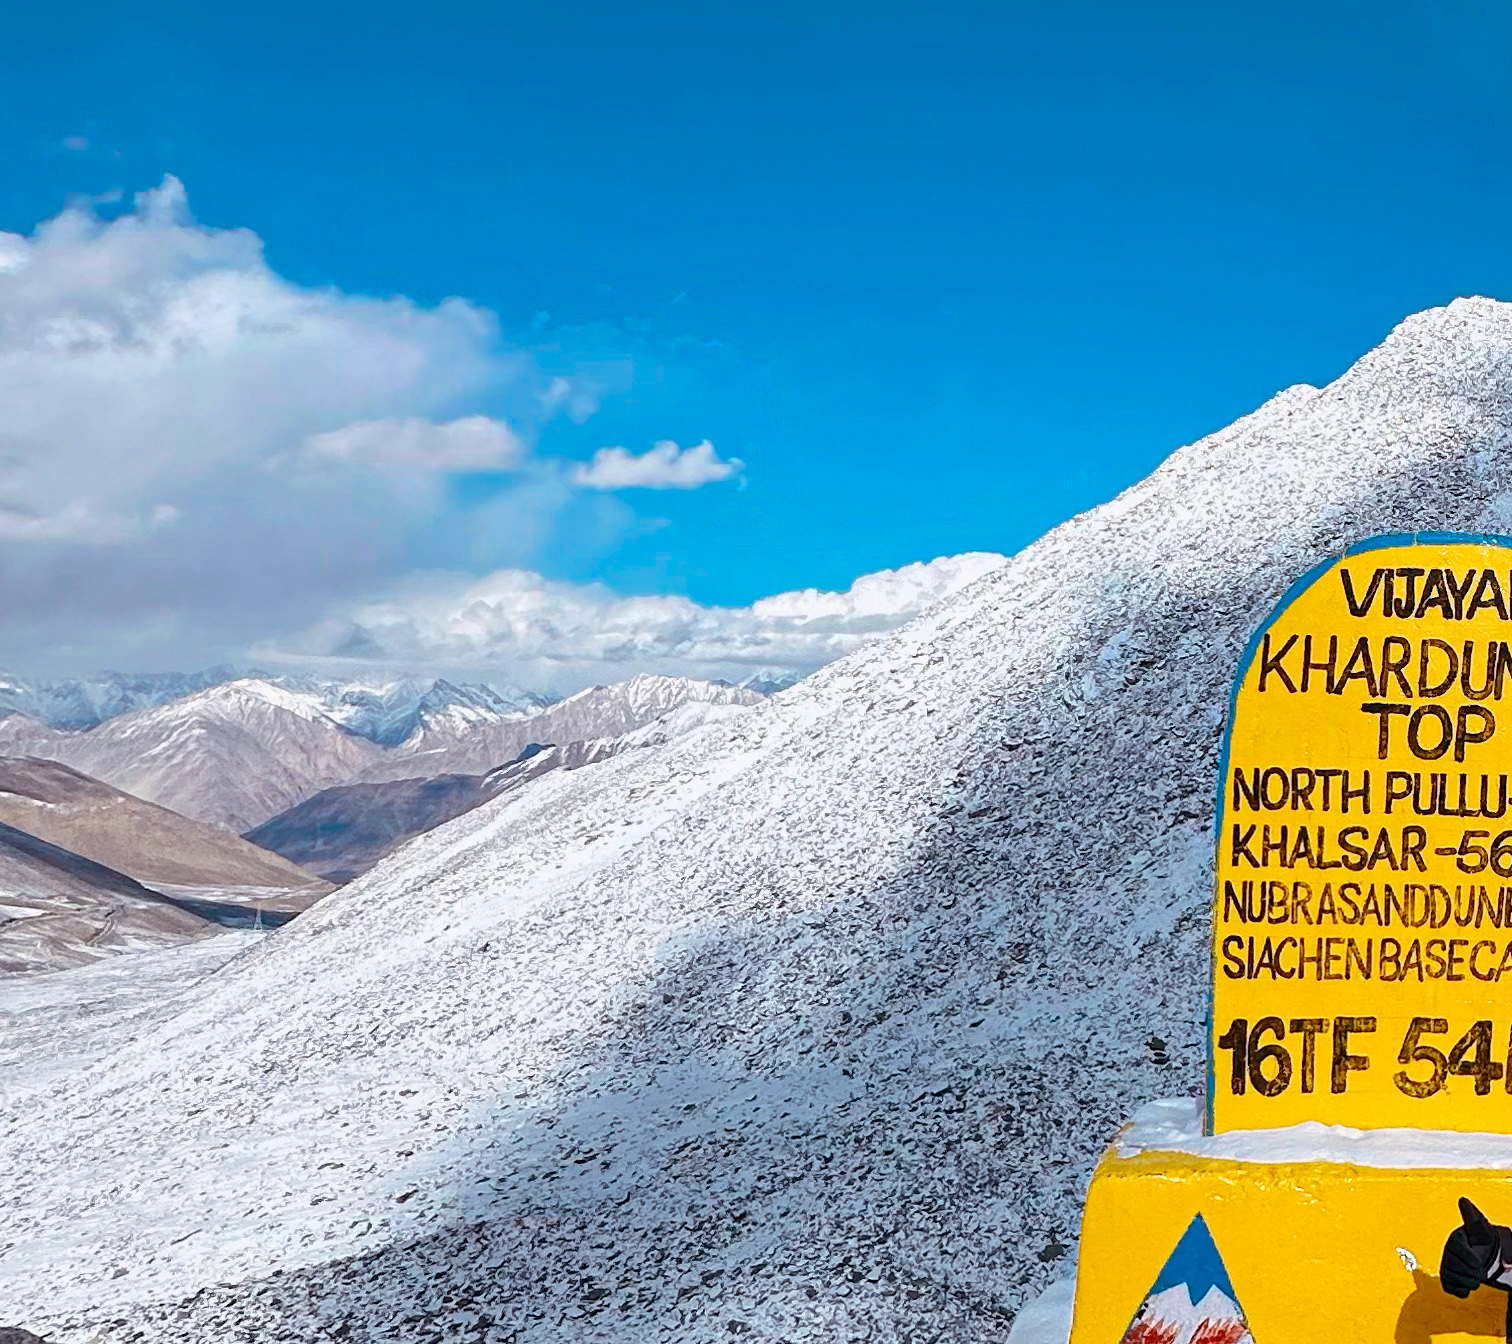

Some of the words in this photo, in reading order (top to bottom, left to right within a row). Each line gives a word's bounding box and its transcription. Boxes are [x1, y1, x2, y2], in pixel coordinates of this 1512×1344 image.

[1361, 702, 1496, 763] TOP
[1232, 766, 1371, 815] NORTH
[1222, 934, 1373, 981] SIACHEN
[1217, 1015, 1377, 1097] 16TF
